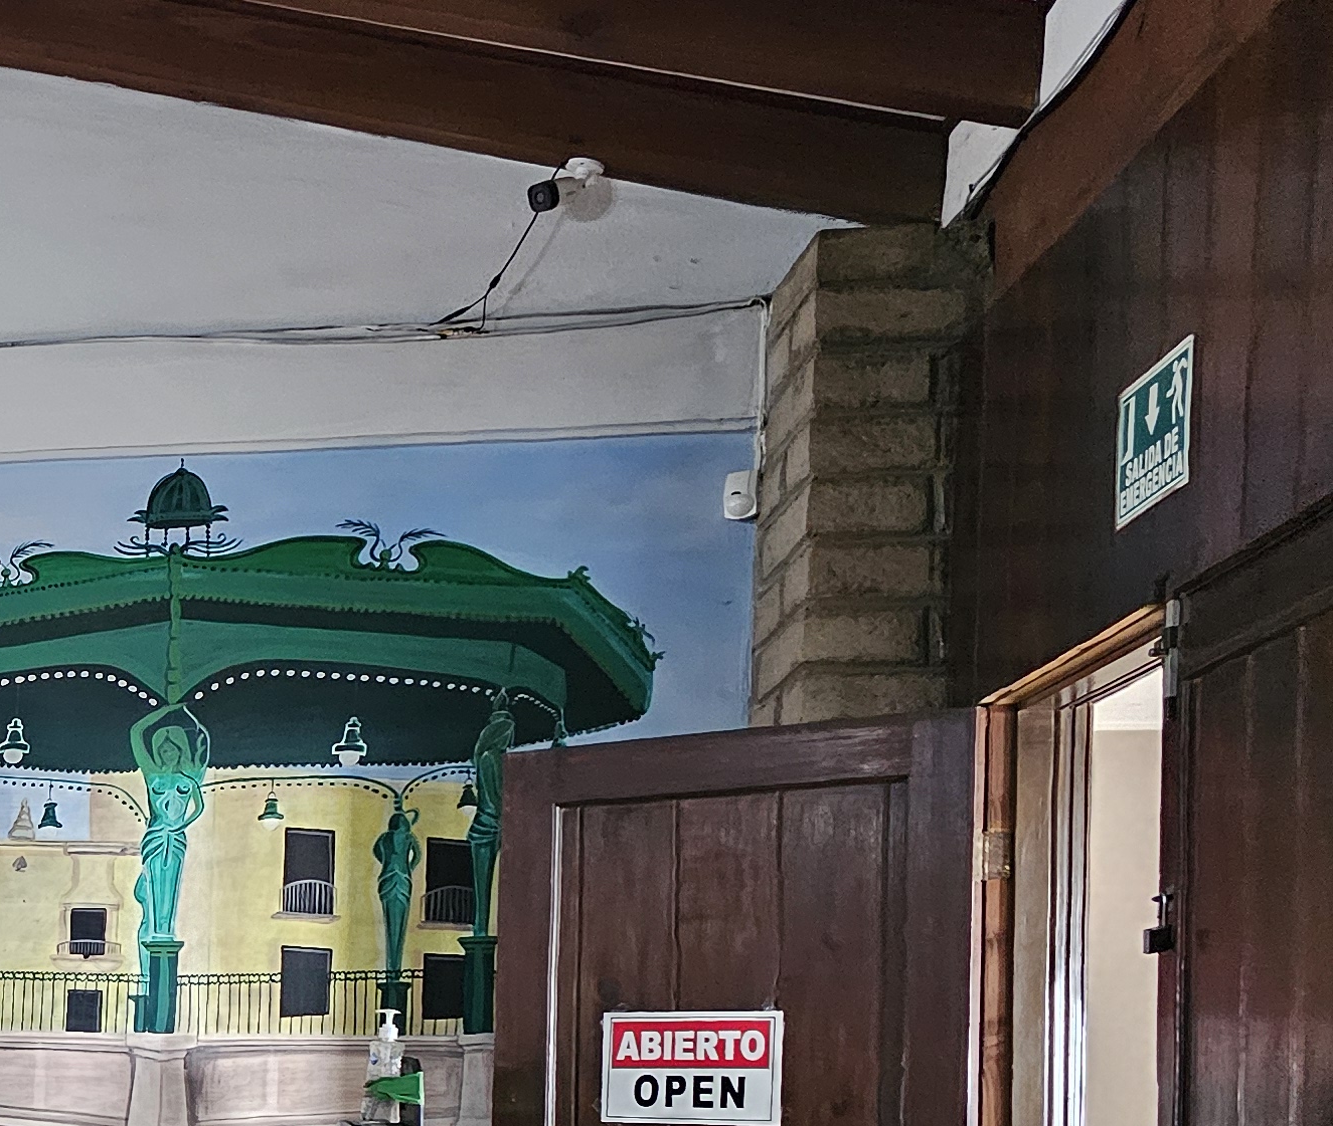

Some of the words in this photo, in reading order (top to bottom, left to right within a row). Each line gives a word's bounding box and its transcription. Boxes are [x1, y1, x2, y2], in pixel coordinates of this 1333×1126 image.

[1125, 440, 1162, 487] SALIDA
[1164, 426, 1179, 459] DE
[1120, 450, 1184, 516] EMERGENCIA
[616, 1030, 766, 1062] ABIERTO
[634, 1074, 746, 1109] OPEN
